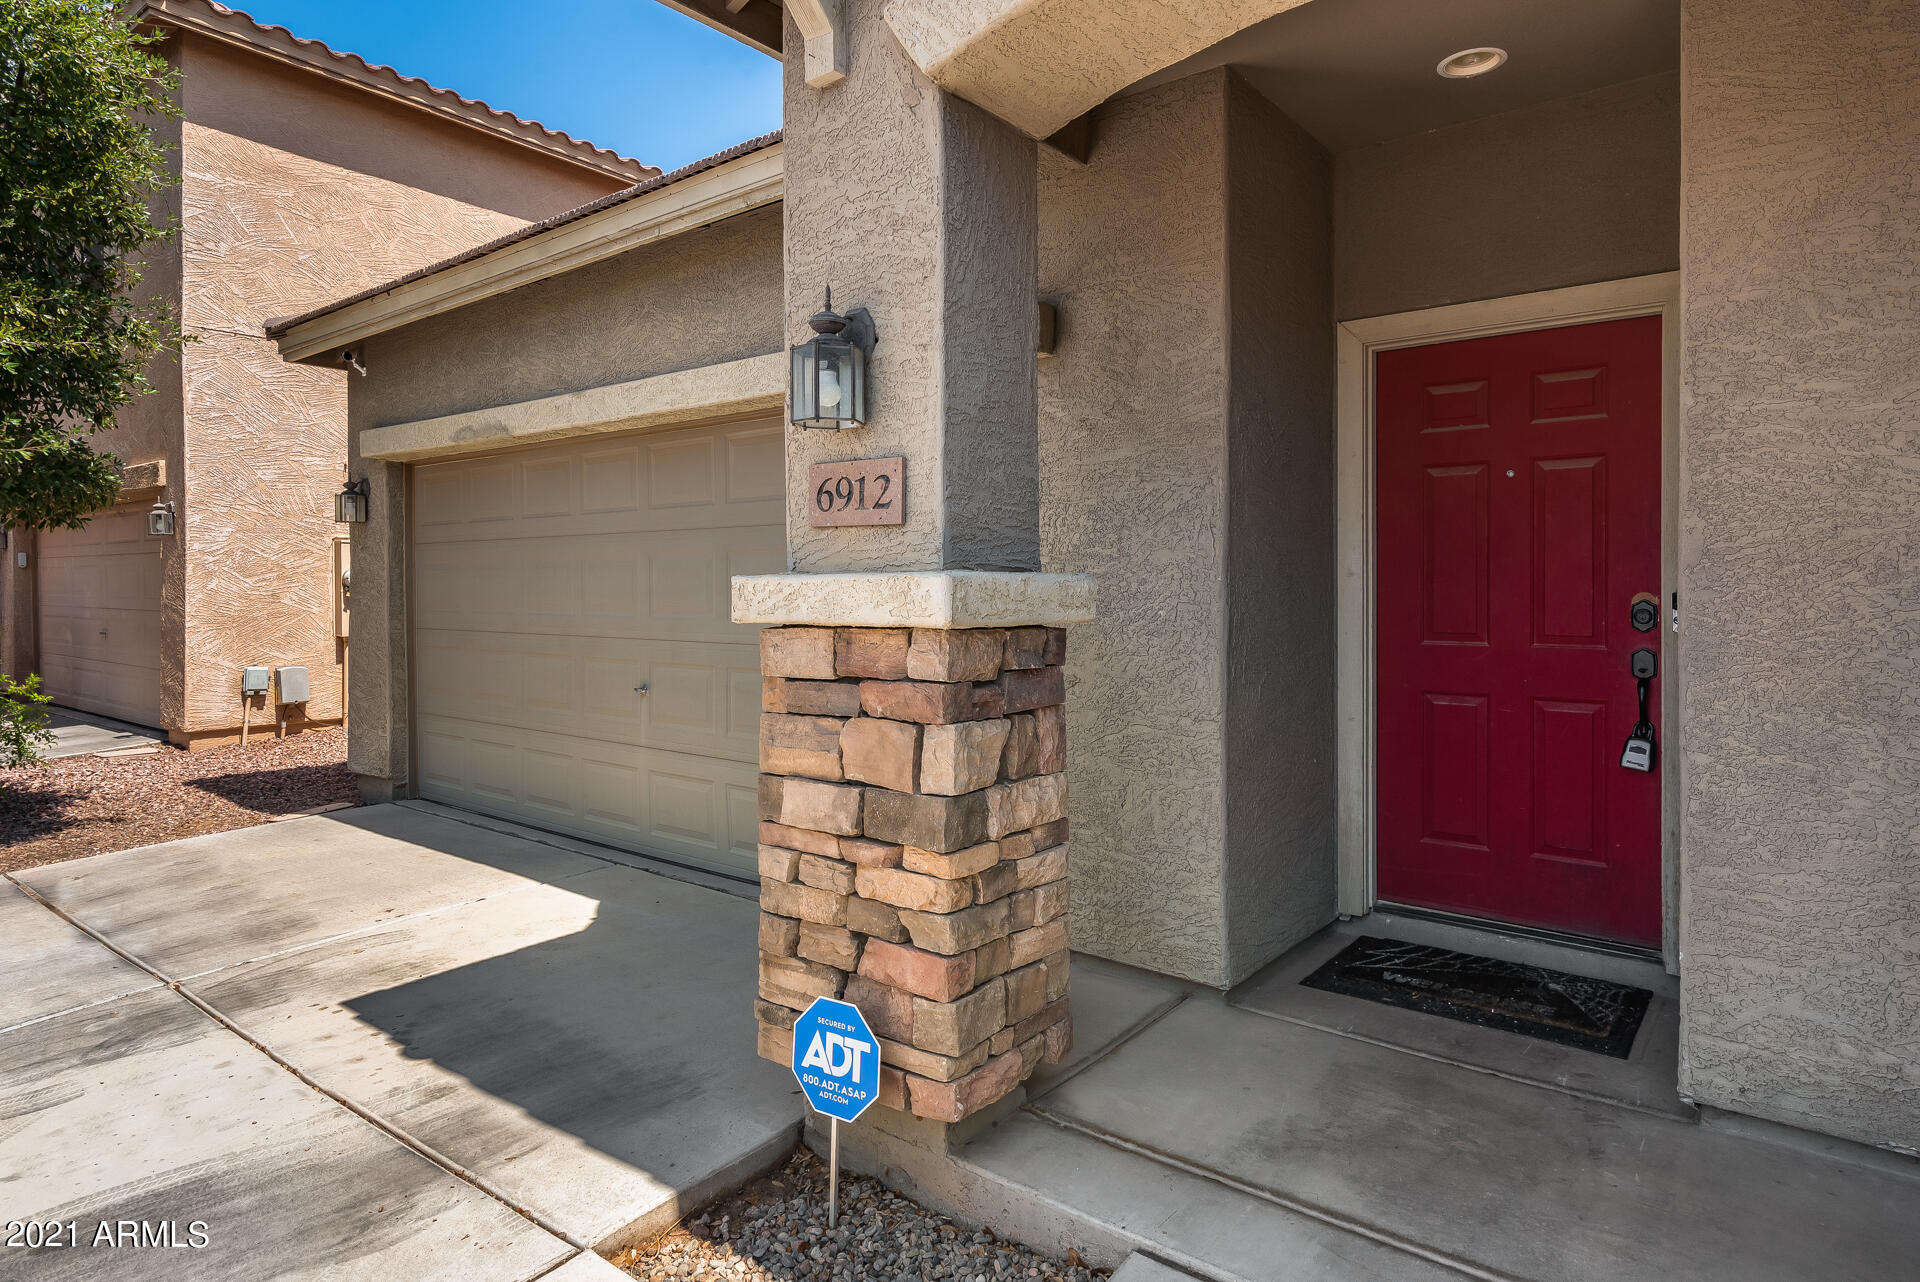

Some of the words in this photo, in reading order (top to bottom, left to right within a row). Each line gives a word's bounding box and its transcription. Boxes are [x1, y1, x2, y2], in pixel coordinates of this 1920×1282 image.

[816, 474, 893, 512] 6912
[817, 1016, 846, 1030] SECURED
[847, 1024, 856, 1033] BY
[801, 1029, 871, 1084] ADT
[803, 1073, 867, 1101] 800.ADT.ASAP
[819, 1090, 849, 1106] ADT.COM
